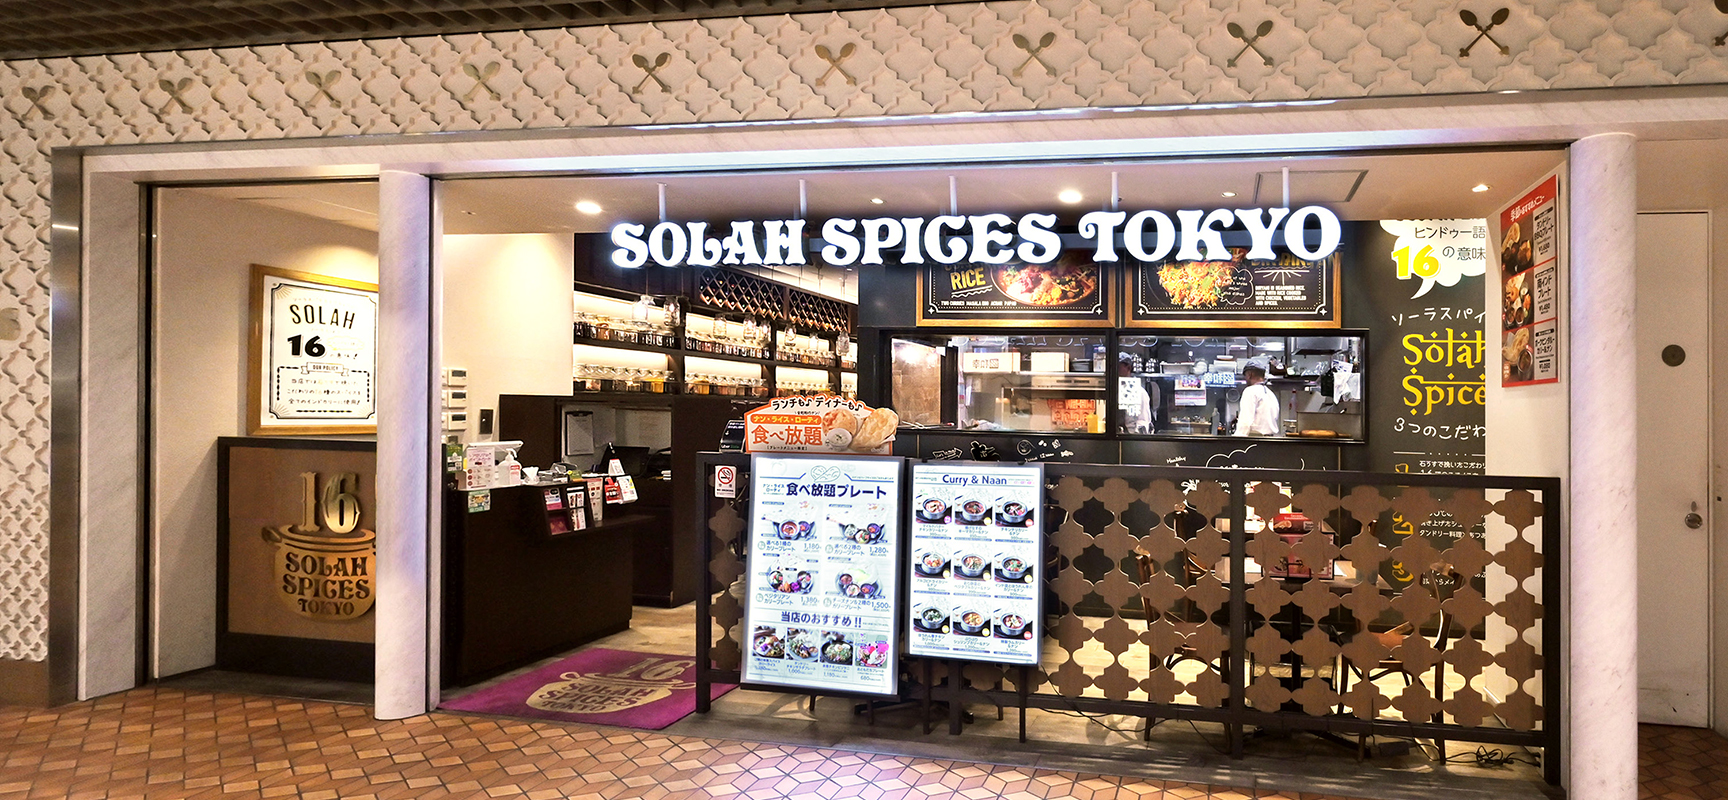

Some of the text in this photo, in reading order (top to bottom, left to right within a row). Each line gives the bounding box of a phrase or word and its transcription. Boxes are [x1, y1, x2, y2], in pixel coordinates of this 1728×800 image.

[610, 206, 1343, 269] SOLAH SPICES TOKYO
[1415, 225, 1486, 239] ヒンドゥー語
[1392, 244, 1486, 279] 16 の意味
[950, 267, 986, 290] RICE
[289, 304, 355, 329] SOLAH
[287, 334, 326, 358] 16
[751, 425, 823, 446] 食べ放題
[786, 482, 887, 499] 食べ放題プレート
[942, 474, 968, 487] Curry
[971, 475, 979, 484] &
[982, 476, 1007, 485] Naan
[298, 471, 360, 534] 16
[285, 551, 368, 577] SOLAH
[282, 573, 370, 600] SPICES
[297, 598, 355, 616] TOKYO
[538, 690, 641, 706] SPICES
[562, 682, 656, 697] SOLAH
